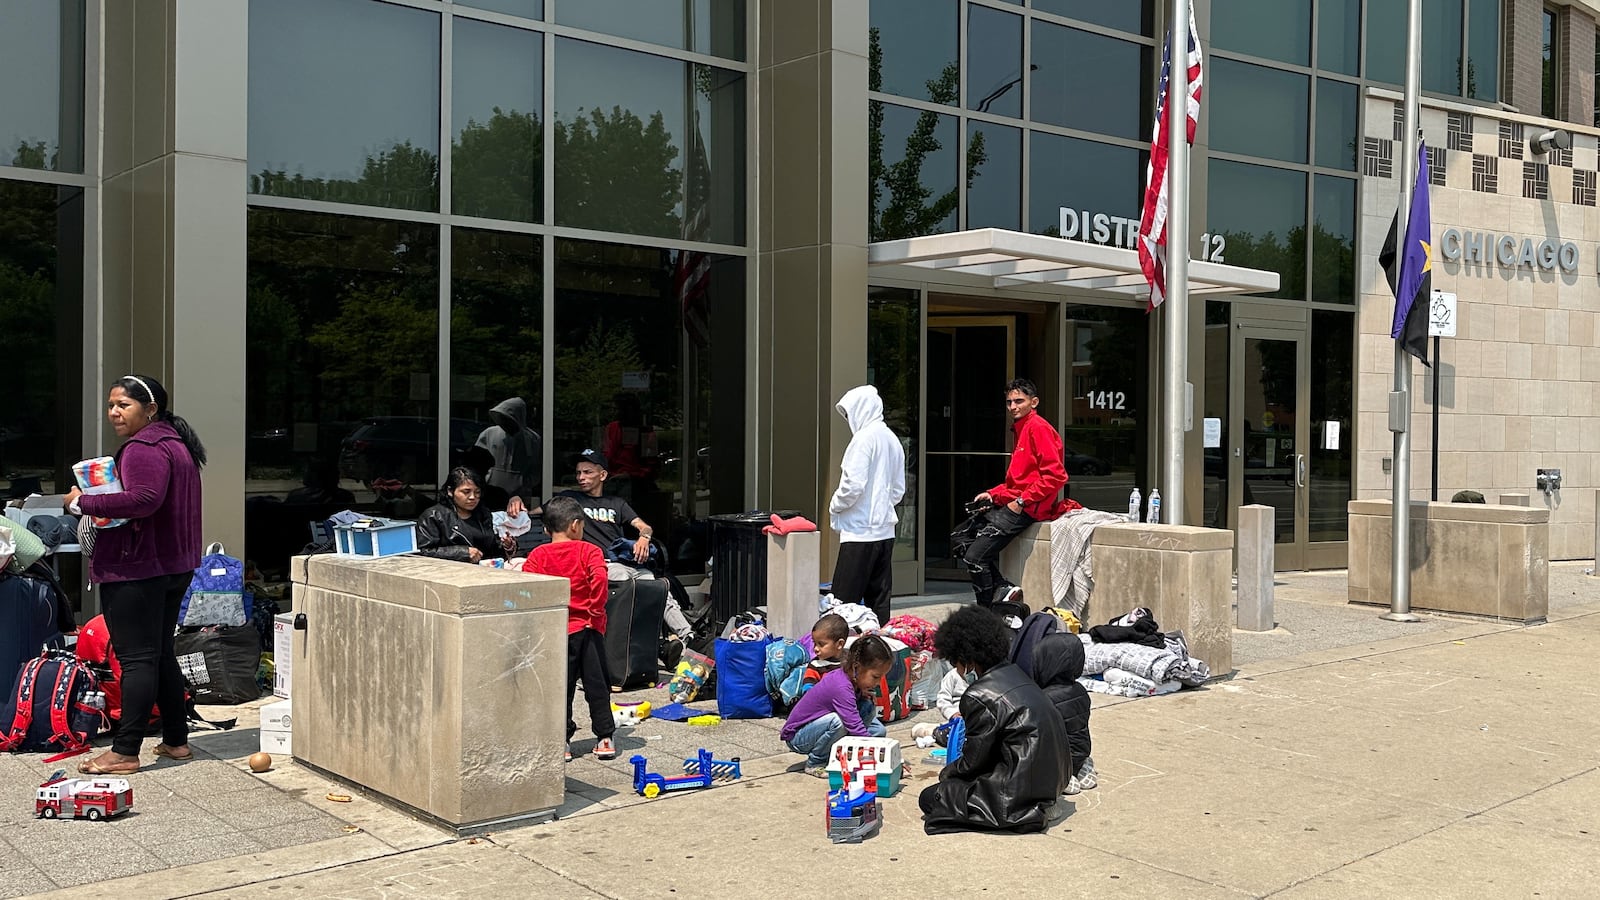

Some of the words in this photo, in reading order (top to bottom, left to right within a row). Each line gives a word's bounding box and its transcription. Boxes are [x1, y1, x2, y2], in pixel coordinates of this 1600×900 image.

[1200, 232, 1226, 263] 12
[1441, 228, 1580, 272] CHICAGO
[1086, 390, 1126, 410] 1412
[583, 507, 617, 523] RIDE
